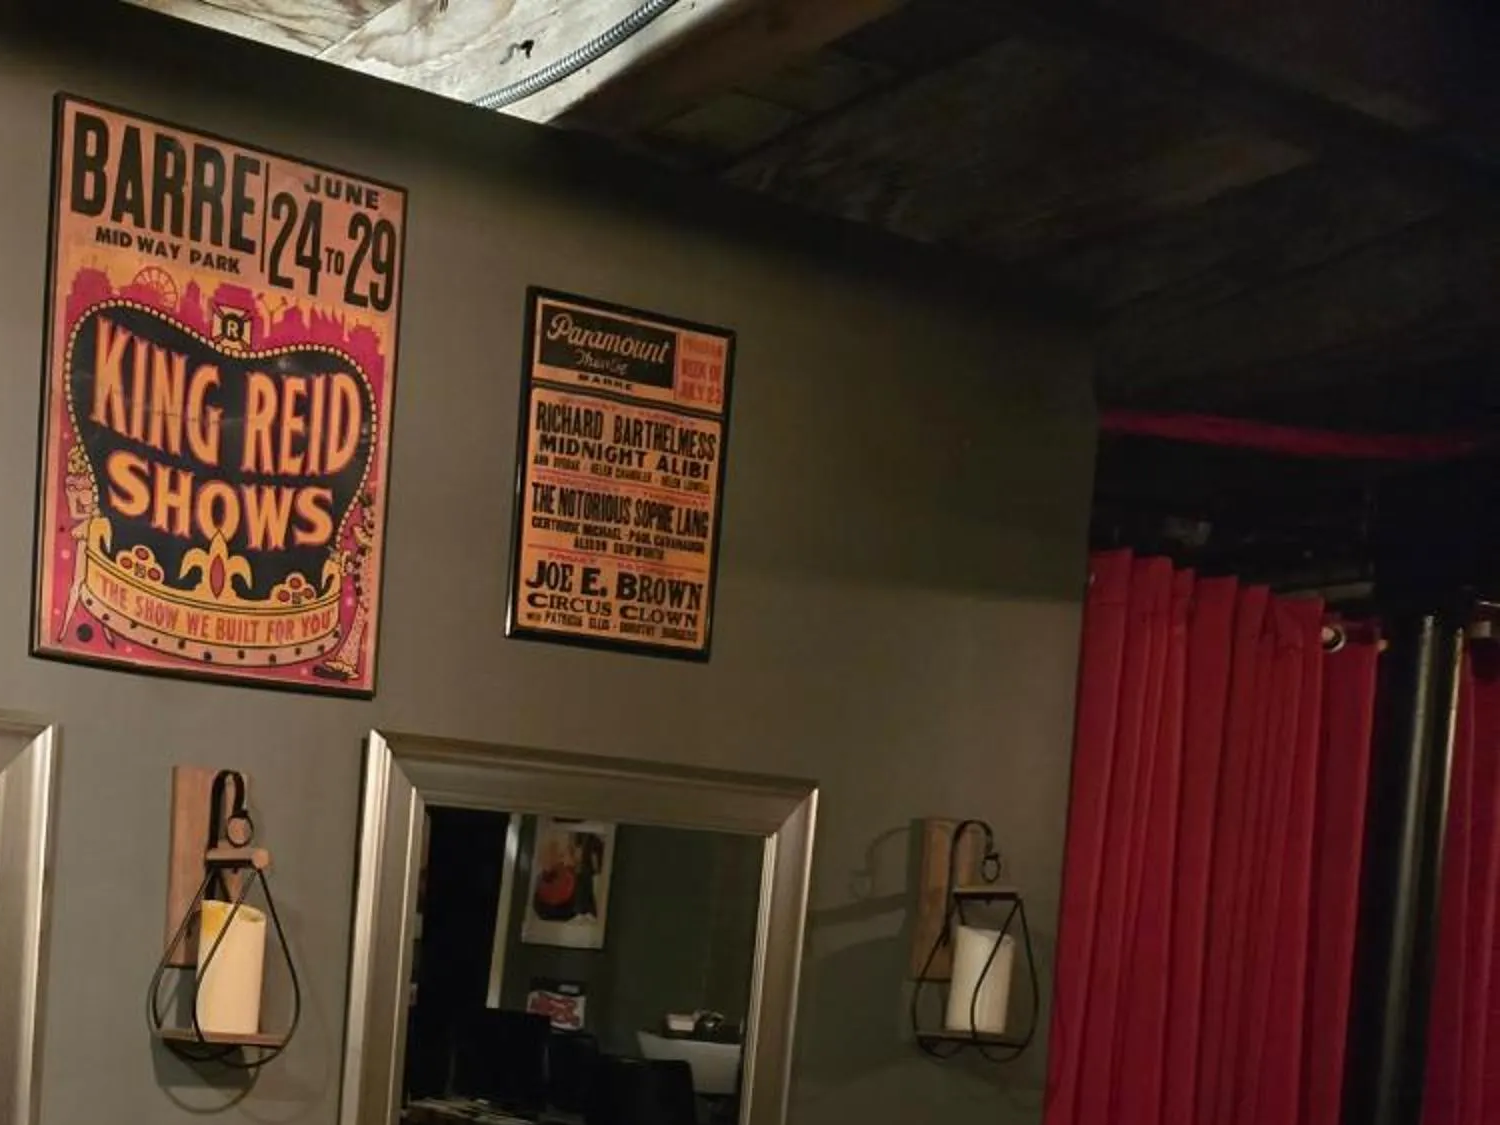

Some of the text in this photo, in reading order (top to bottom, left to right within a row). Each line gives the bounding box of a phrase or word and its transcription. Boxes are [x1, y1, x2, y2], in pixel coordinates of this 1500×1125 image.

[69, 110, 261, 256] BARRE
[303, 174, 380, 211] JUNE
[95, 225, 242, 275] MID WAY PARK
[268, 191, 397, 313] 24 TO 29
[547, 313, 670, 364] Paramount
[89, 317, 361, 477] KING REID
[536, 400, 604, 440] RICHARD
[613, 415, 717, 462] BARTHELMESS
[539, 434, 709, 481] MIDNIGHT ALIBI
[105, 448, 334, 551] SHOWS
[532, 482, 555, 513] THE
[558, 487, 632, 525] NOTORIOUS
[100, 575, 128, 611] THE
[135, 595, 178, 631] SHOW
[186, 610, 211, 638] WE
[215, 615, 259, 643] BUILT
[267, 619, 294, 643] FOR
[526, 559, 573, 592] JOE
[580, 567, 607, 598] E.
[616, 572, 703, 610] BROWN
[527, 593, 698, 628] CIRCUS CLOWN
